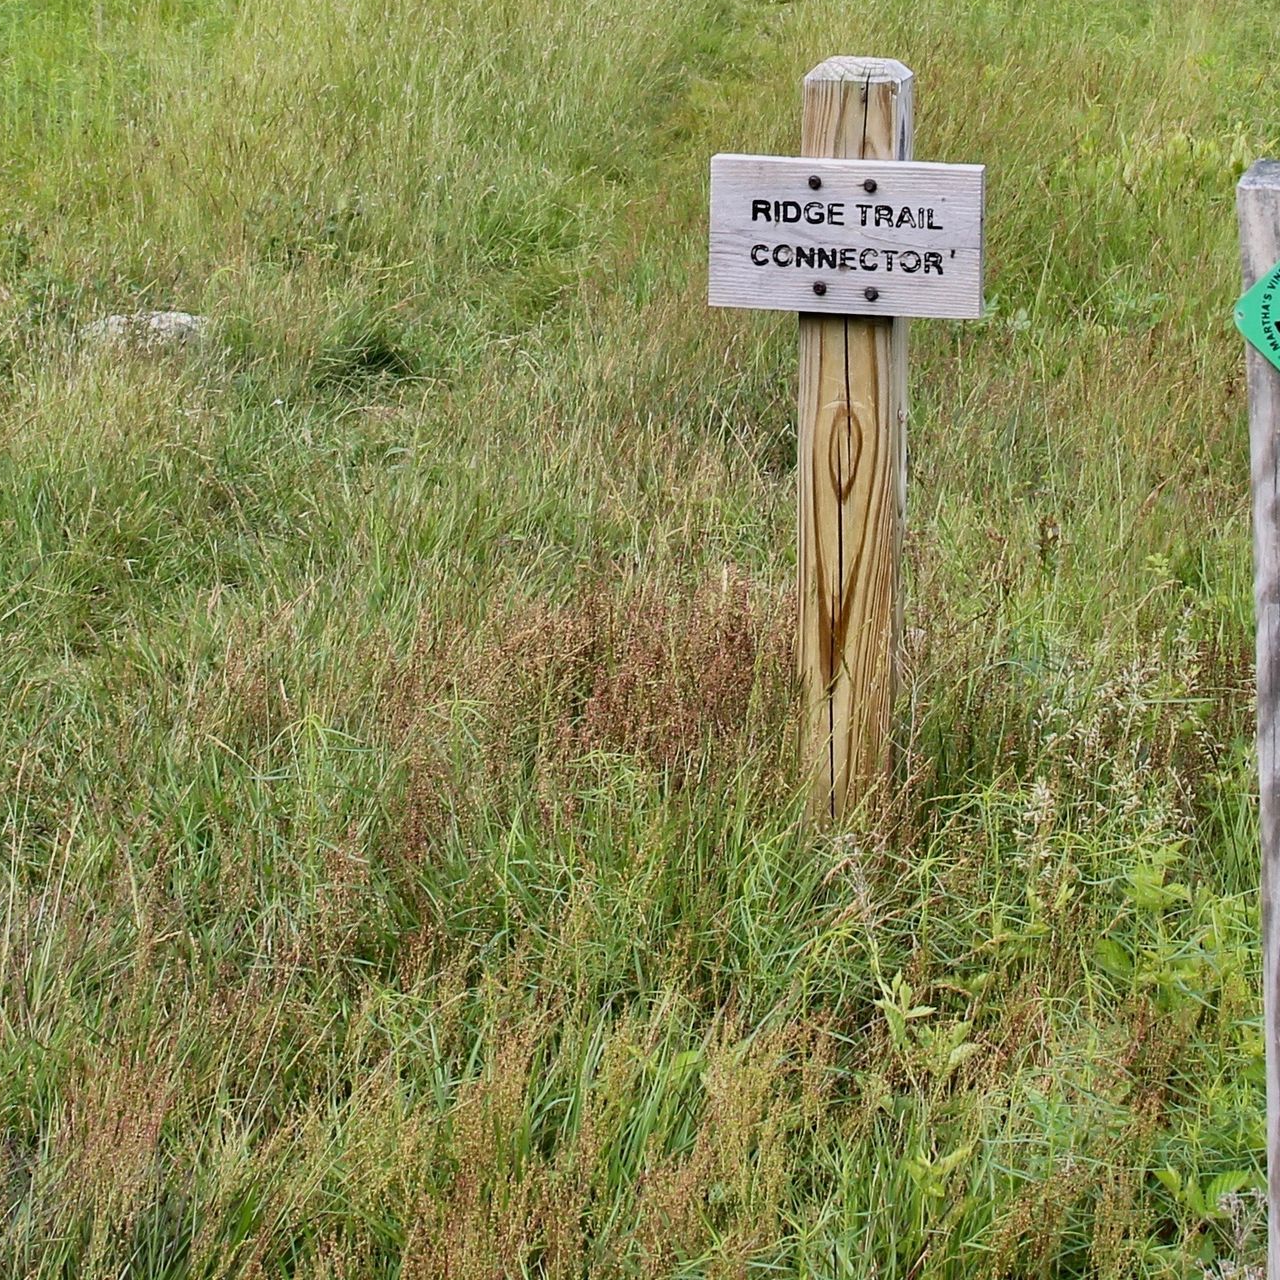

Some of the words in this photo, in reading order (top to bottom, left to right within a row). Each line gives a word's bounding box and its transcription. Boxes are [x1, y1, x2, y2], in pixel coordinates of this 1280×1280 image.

[751, 199, 845, 226] RIDGE
[856, 204, 943, 230] TRAIL
[1260, 293, 1280, 352] MARTHA'S
